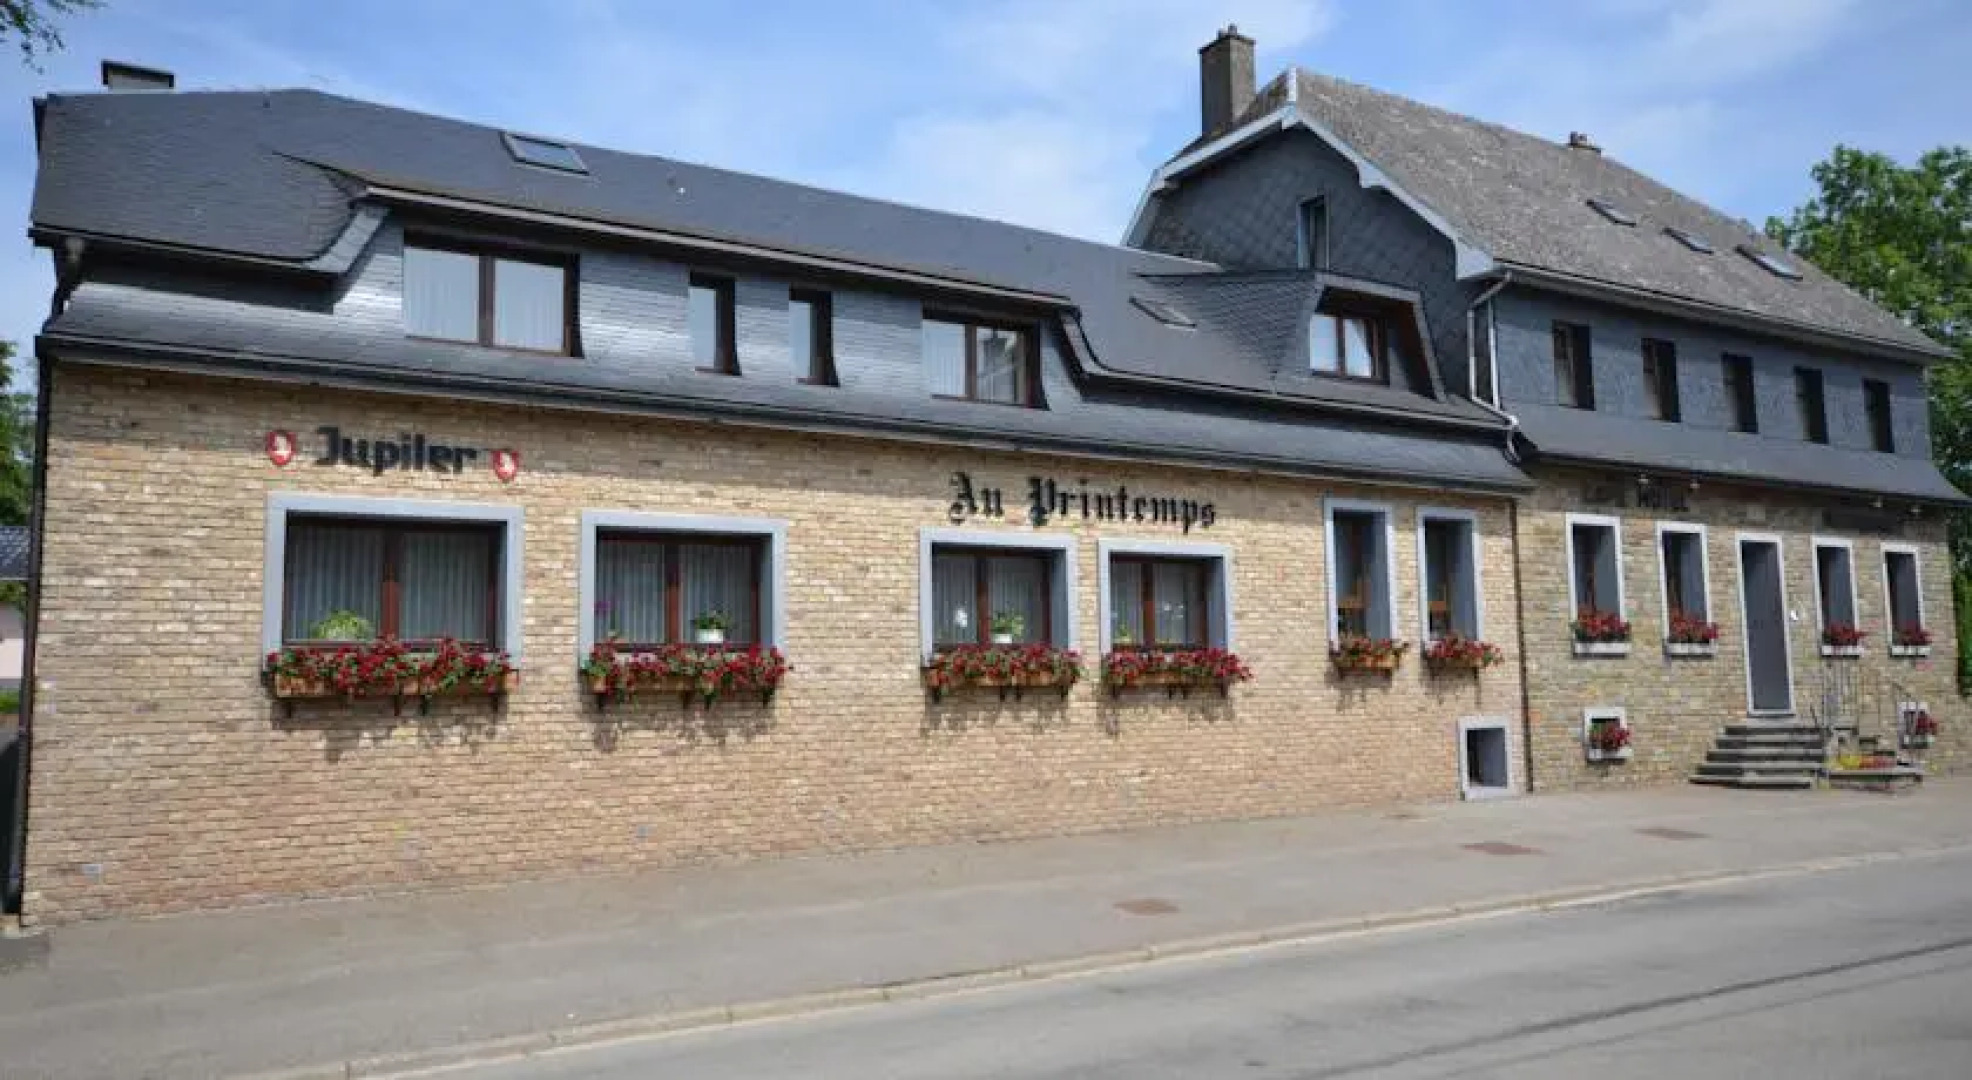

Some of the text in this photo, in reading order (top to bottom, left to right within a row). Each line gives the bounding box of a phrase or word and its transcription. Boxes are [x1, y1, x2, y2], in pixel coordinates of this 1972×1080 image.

[315, 426, 478, 477] Jupiler
[949, 471, 1216, 535] Au Printemps
